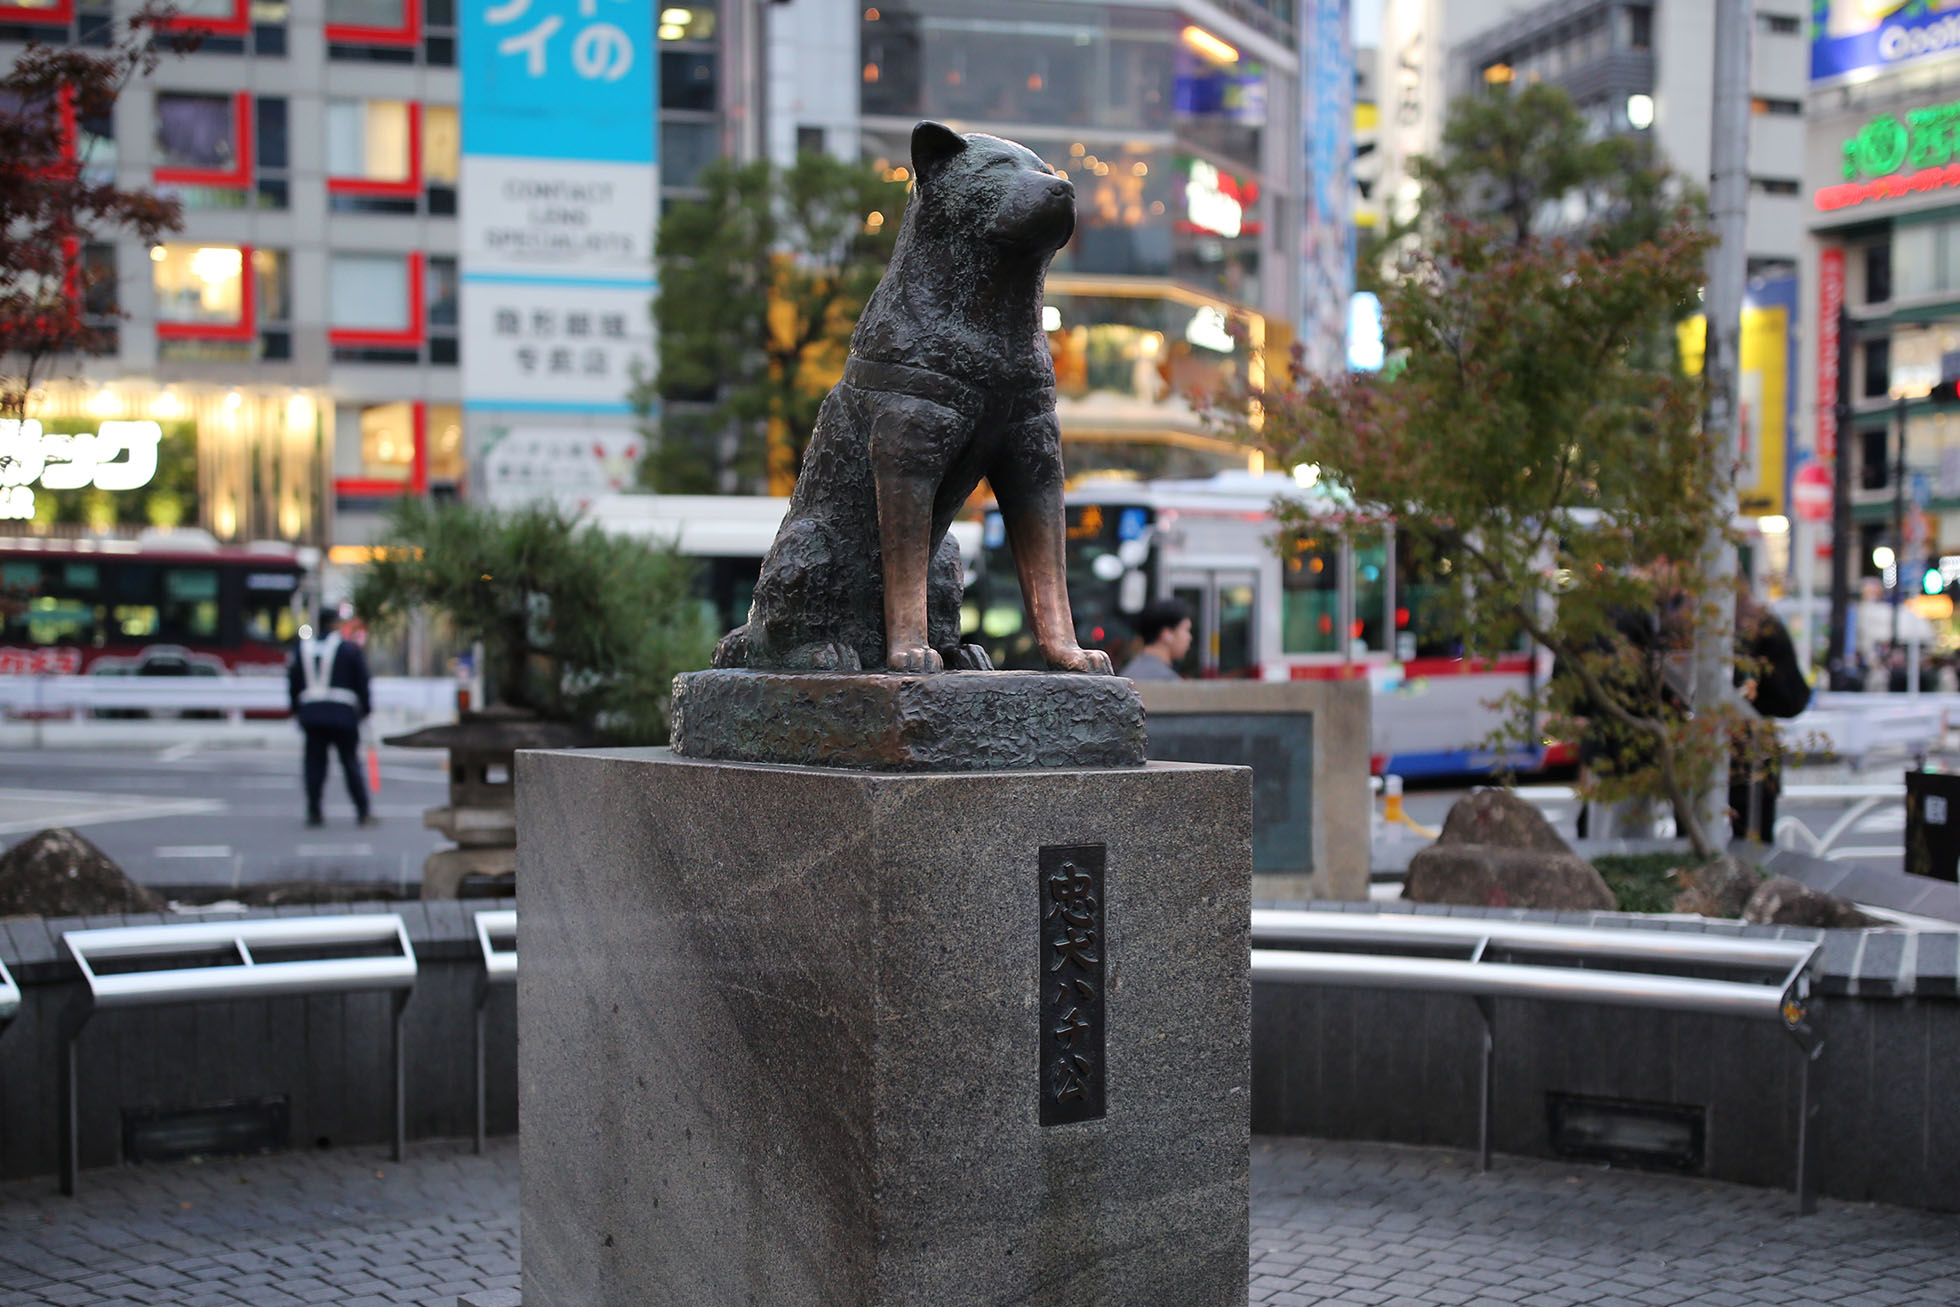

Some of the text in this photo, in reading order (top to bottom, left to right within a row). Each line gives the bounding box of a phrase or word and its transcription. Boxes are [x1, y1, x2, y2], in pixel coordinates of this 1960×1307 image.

[502, 179, 615, 203] CONTACT
[529, 207, 589, 226] LENS
[485, 226, 635, 252] SPECIALISTS
[1045, 862, 1099, 1105] 忠犬ハチ公
